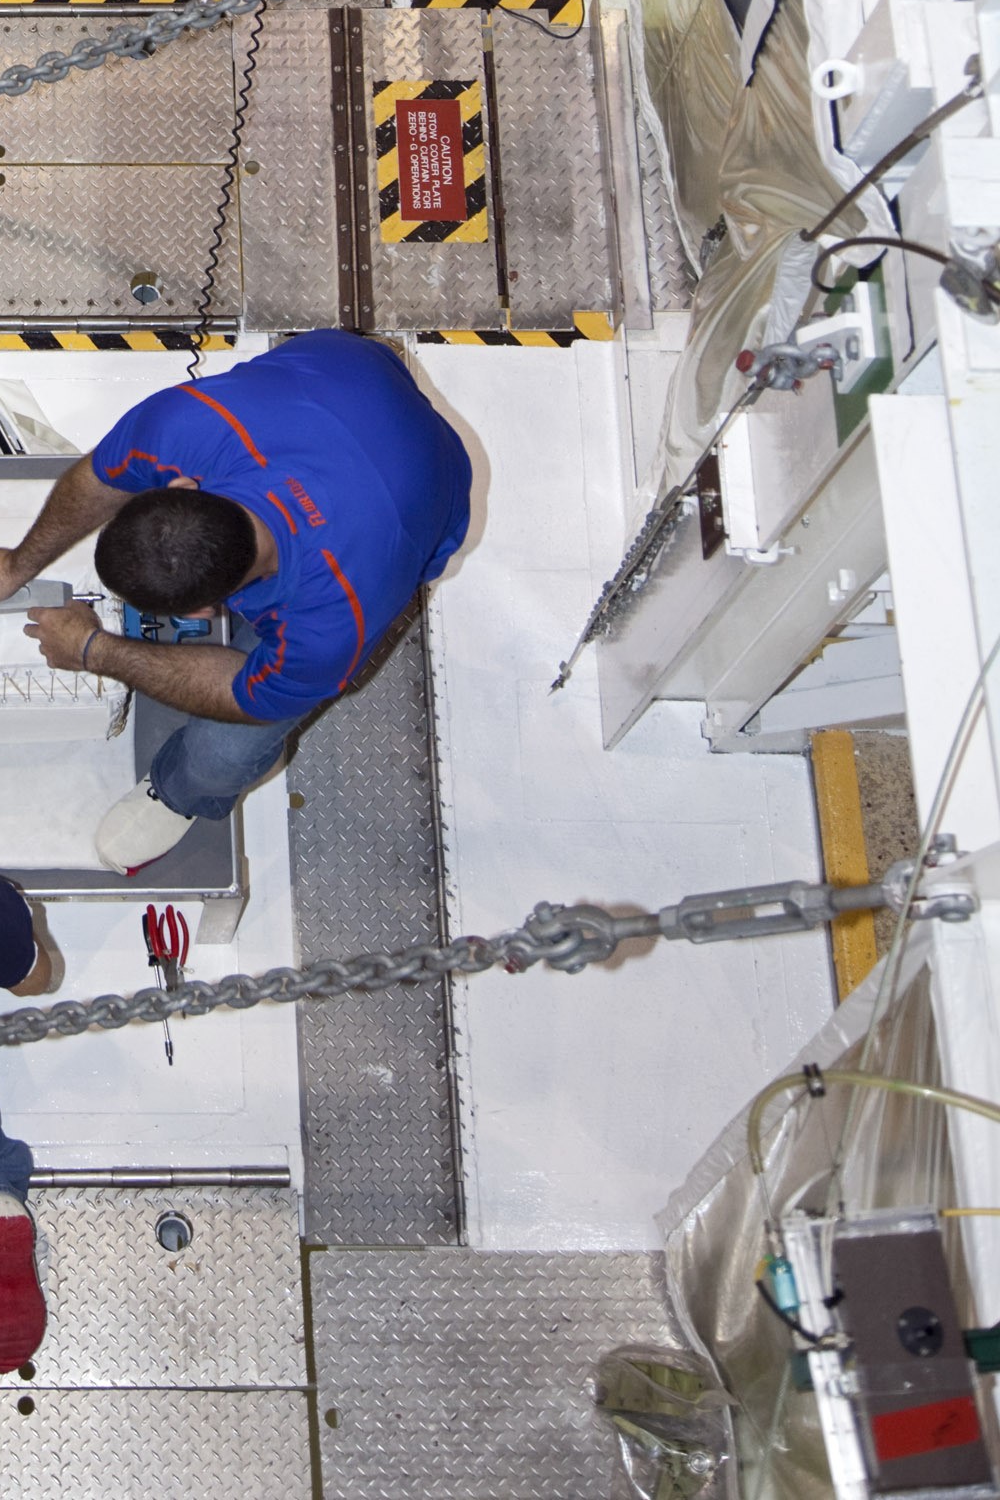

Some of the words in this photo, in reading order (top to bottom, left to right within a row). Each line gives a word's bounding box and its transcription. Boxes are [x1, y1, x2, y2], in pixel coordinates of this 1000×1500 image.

[408, 111, 418, 136] ZERO
[418, 111, 428, 143] BEHIND
[428, 112, 438, 140] STOW
[409, 143, 419, 151] G
[430, 143, 440, 176] COVER
[440, 135, 453, 185] CAUTION
[420, 145, 430, 183] CURTAIN
[410, 153, 421, 209] OPERATIONS
[431, 180, 441, 209] PLATE
[422, 190, 432, 209] FOR
